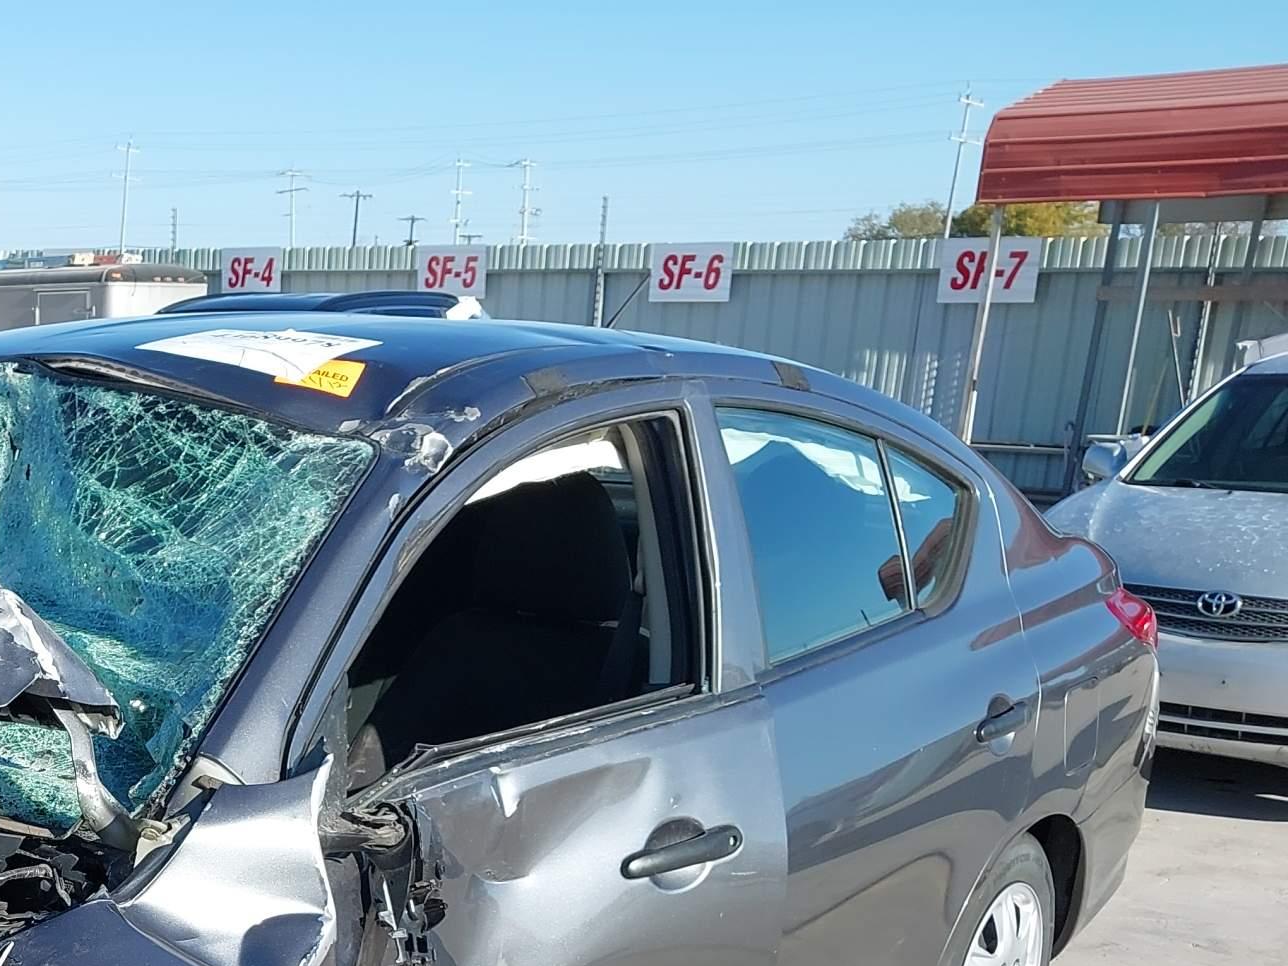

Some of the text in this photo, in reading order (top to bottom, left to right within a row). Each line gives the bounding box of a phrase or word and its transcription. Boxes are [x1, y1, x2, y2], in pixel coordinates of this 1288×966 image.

[228, 257, 274, 288] SF-4
[424, 255, 479, 288] SF-5
[658, 254, 724, 290] SF-6
